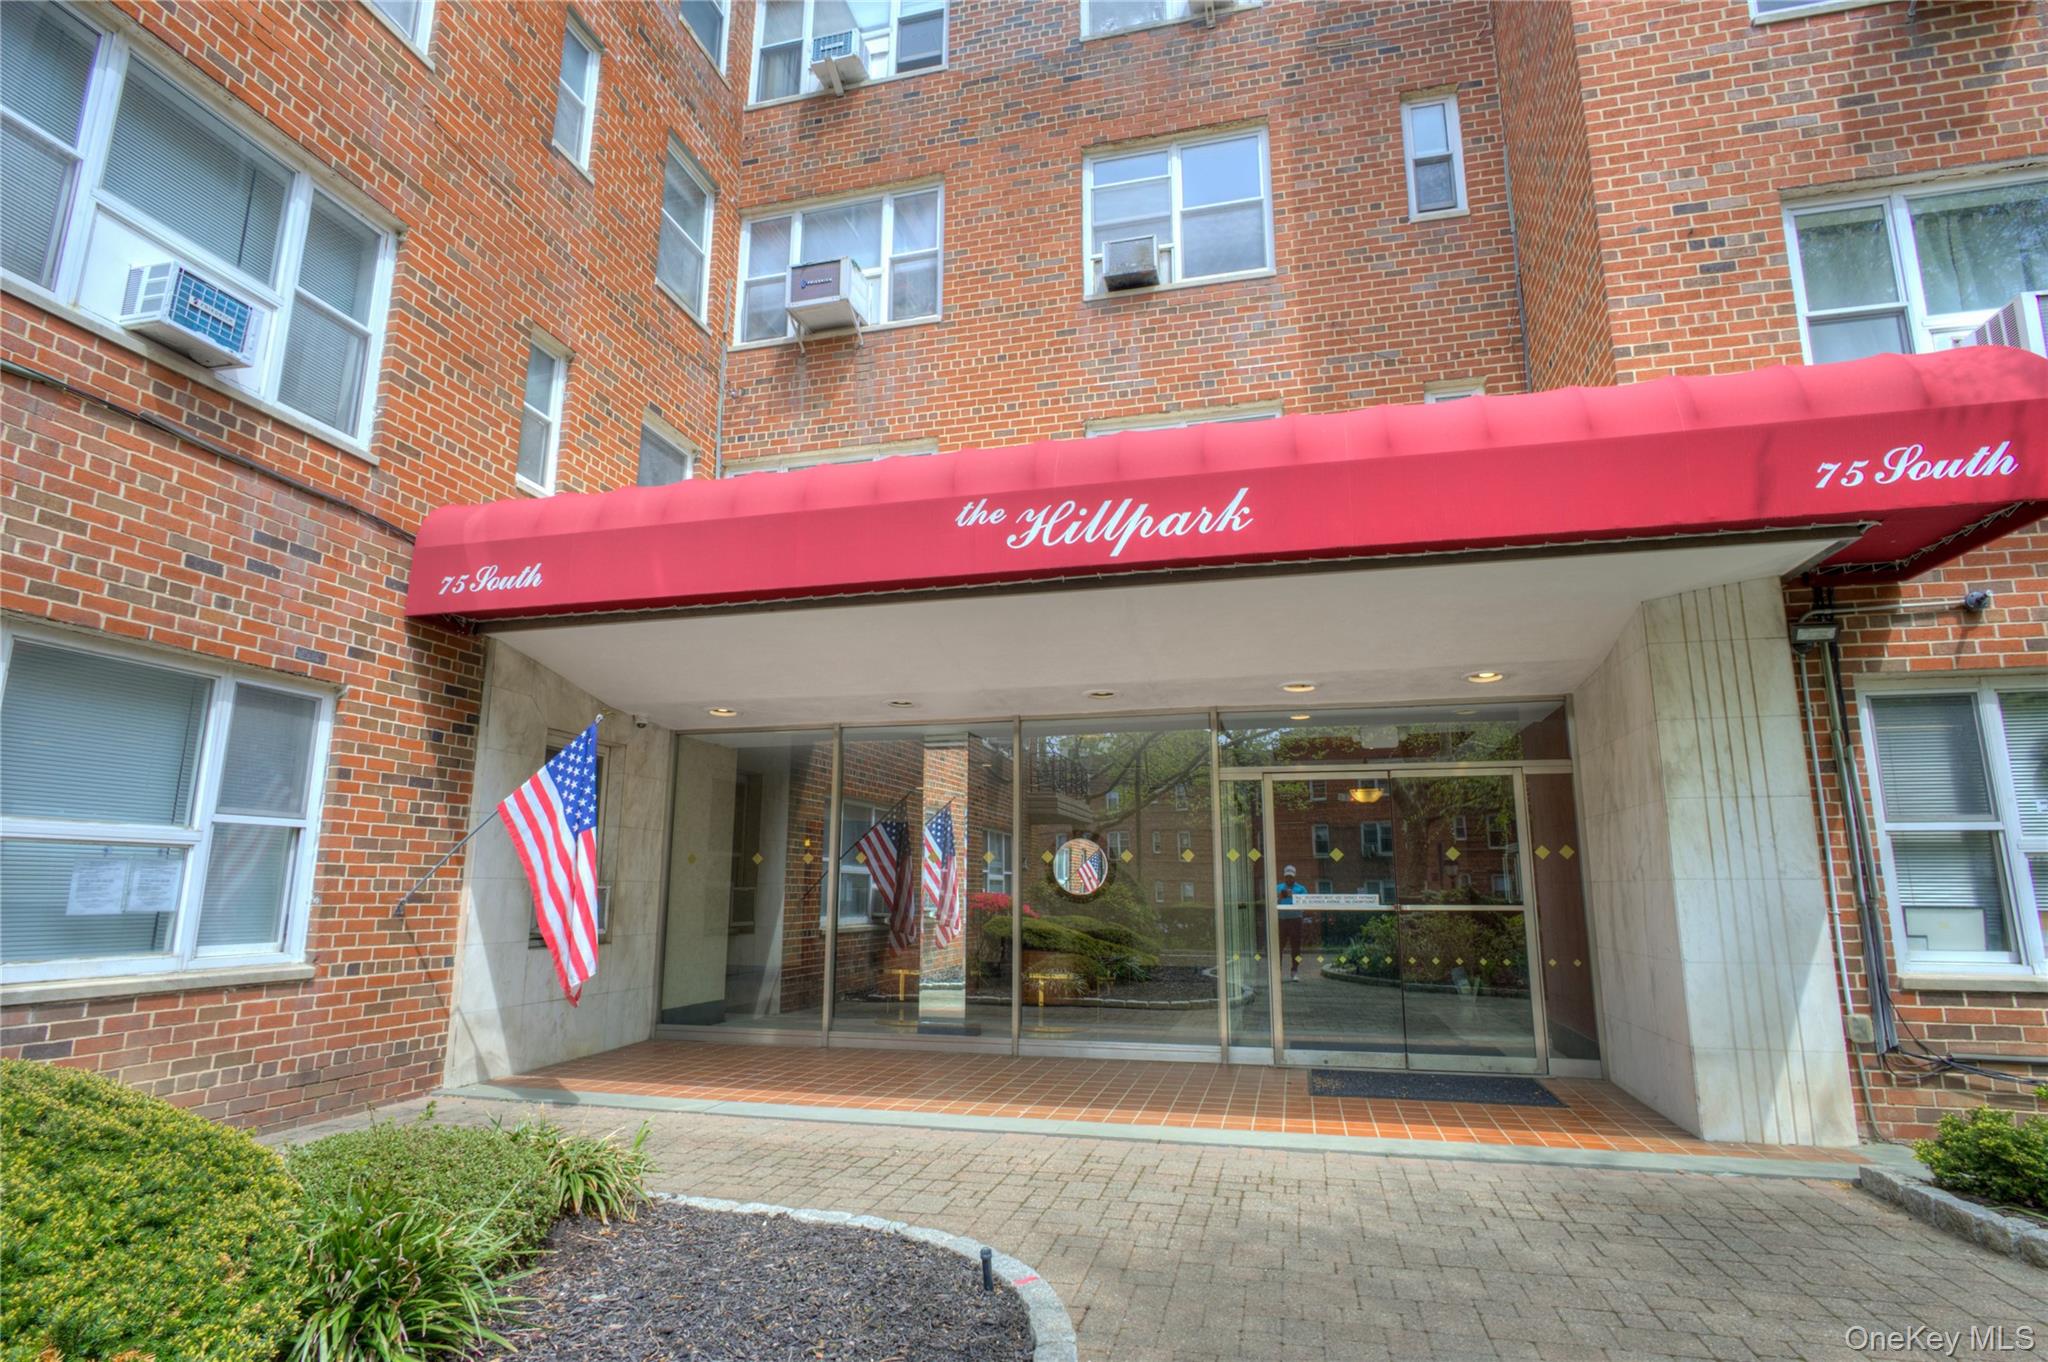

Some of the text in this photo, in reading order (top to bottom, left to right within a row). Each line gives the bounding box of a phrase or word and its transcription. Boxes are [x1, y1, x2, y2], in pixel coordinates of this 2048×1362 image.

[1816, 440, 2019, 488] 75 South
[955, 488, 1253, 557] the Hillpark
[438, 562, 543, 595] 75 South
